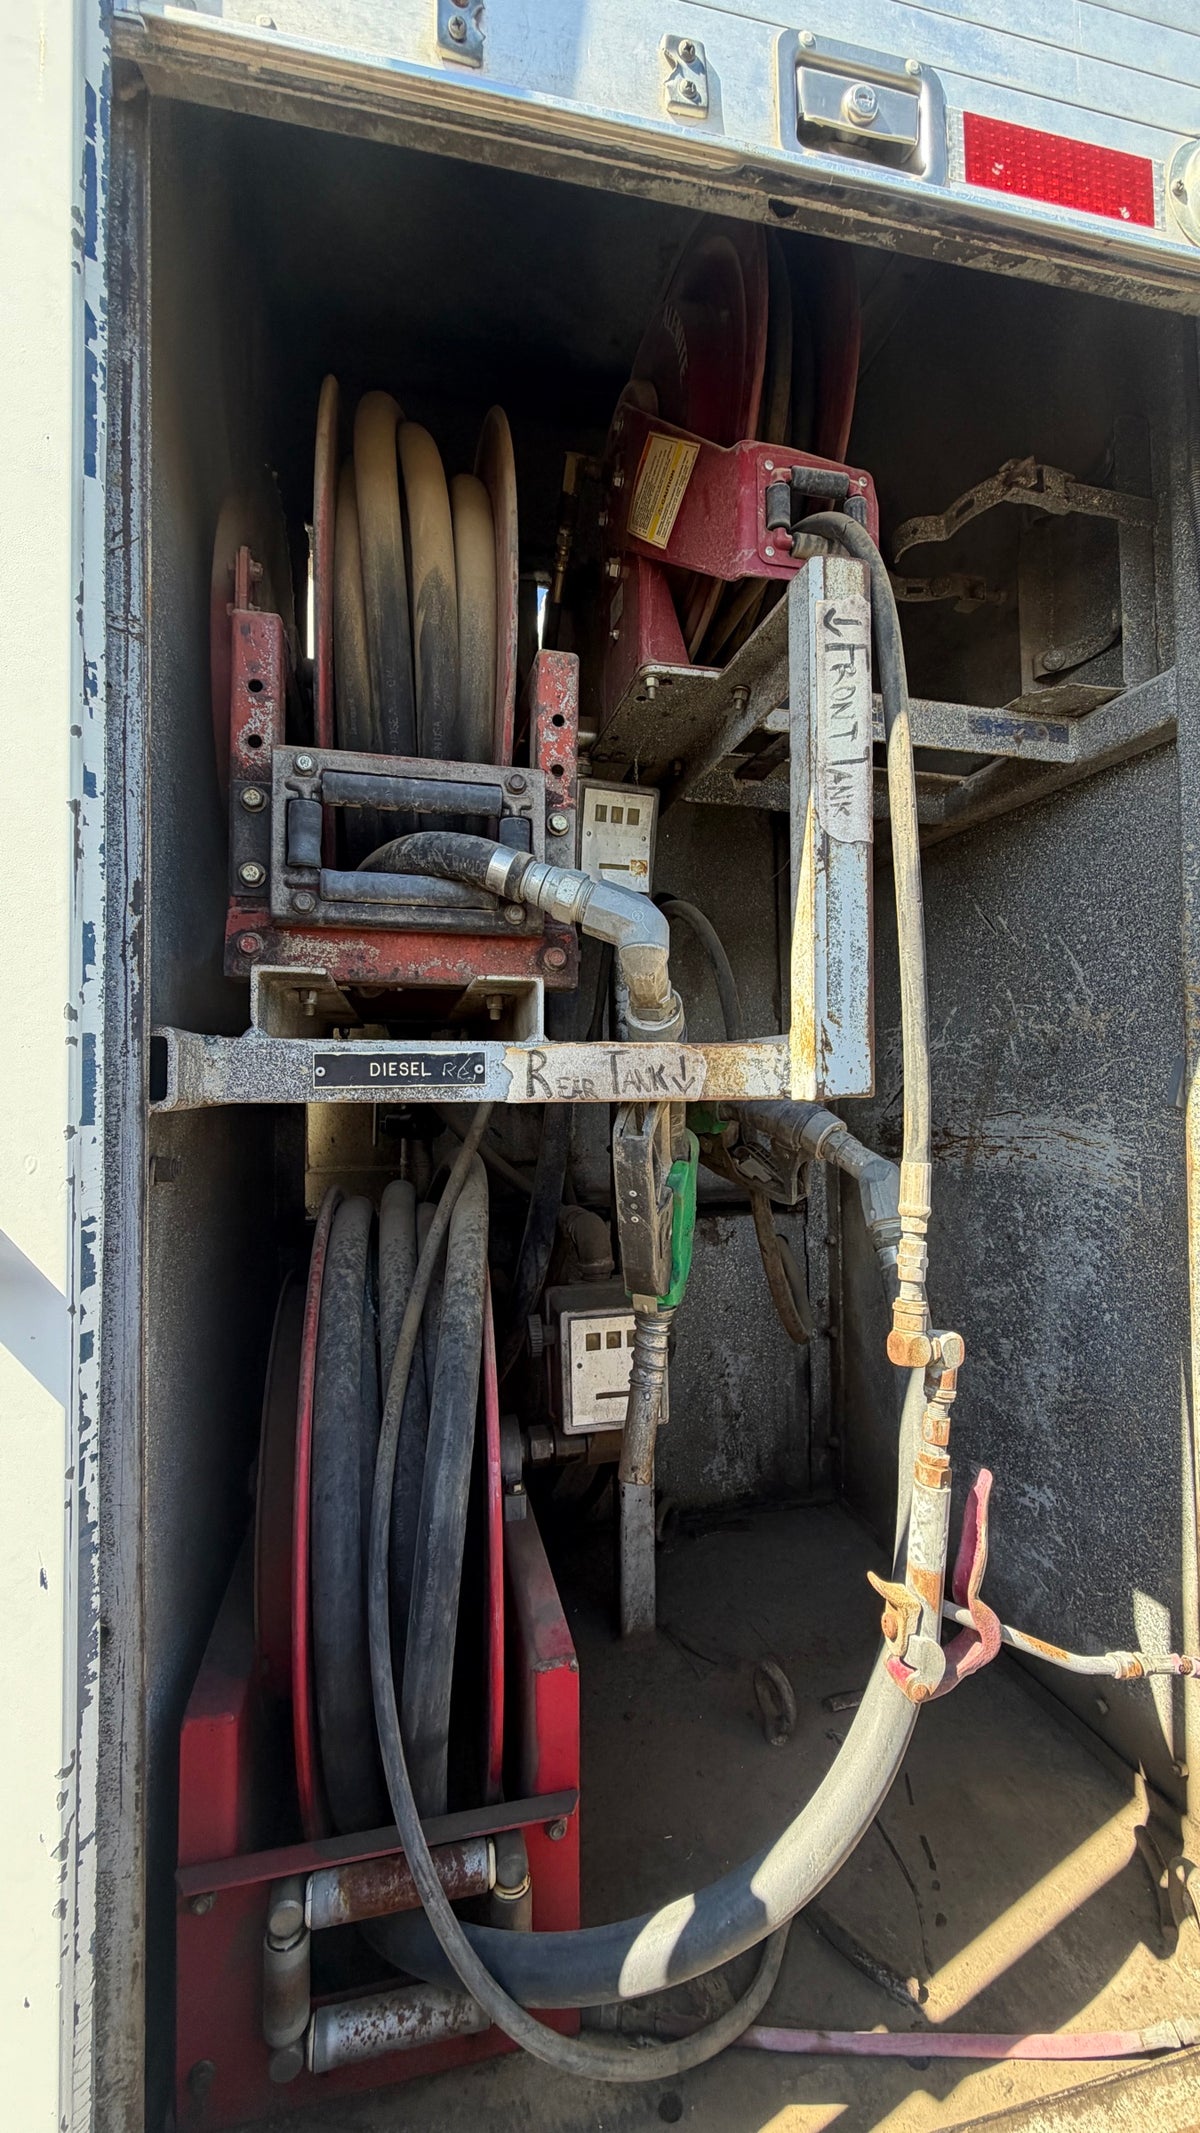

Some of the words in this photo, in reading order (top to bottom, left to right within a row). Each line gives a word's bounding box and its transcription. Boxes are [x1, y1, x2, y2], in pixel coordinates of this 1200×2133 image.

[661, 469, 676, 506] CAUTION
[825, 643, 870, 742] FRONT
[825, 746, 870, 818] TANK
[369, 1061, 432, 1077] DIESEL
